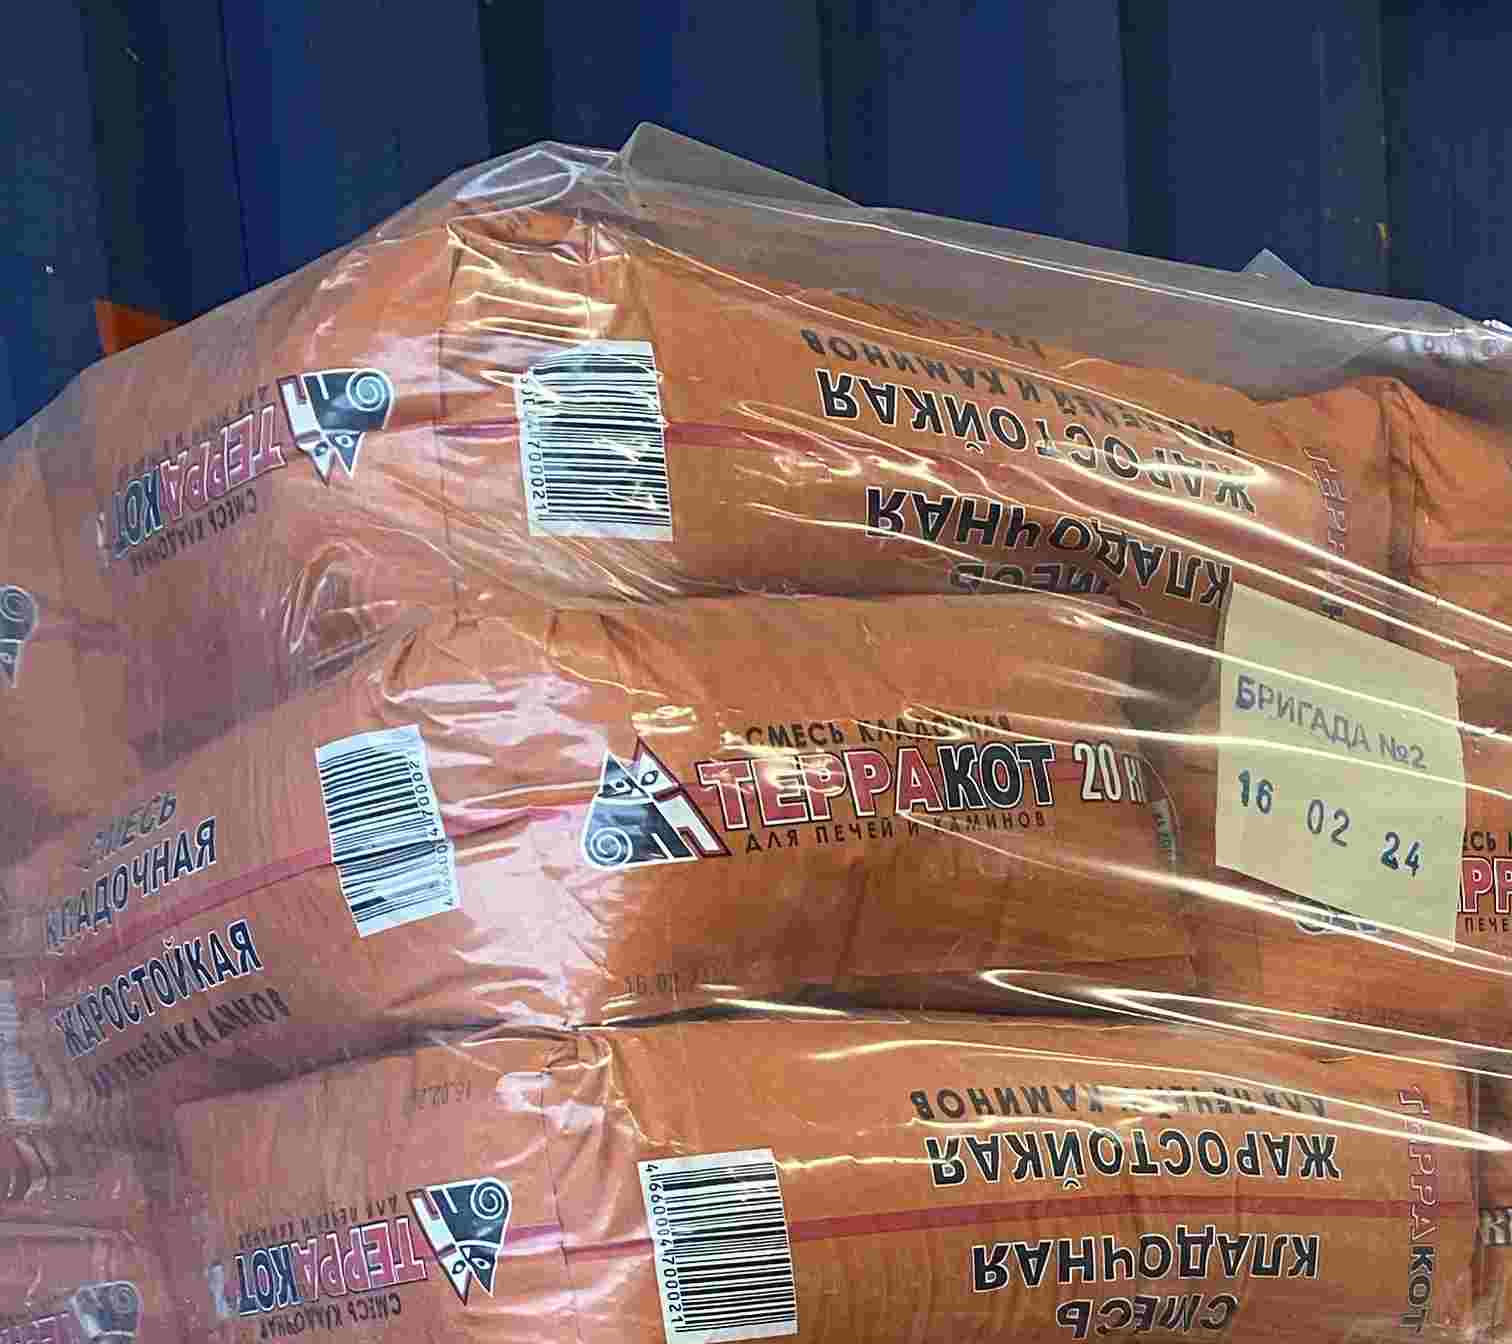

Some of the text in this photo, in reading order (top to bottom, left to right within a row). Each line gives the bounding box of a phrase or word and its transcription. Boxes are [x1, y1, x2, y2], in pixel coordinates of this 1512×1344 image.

[864, 488, 1234, 609] КЛАДОЧНАЯ
[745, 721, 845, 750] СМЕСЬ
[1235, 676, 1427, 770] БРИГАДА №2
[697, 742, 1120, 833] ТЕРРАКОТ 20
[745, 811, 1046, 853] ДЛЯ ПЕЧЕЙ И КАМИНОВ
[1238, 770, 1422, 877] 16 02 24
[57, 919, 264, 1060] ЖАРОСТОЙКАЯ
[925, 1129, 1342, 1191] ЖАРОСТОЙКАЯ
[236, 1220, 429, 1317] ТЕРРАКОТ
[971, 1224, 1319, 1294] КЛАДОЧНАЯ
[1055, 1293, 1239, 1339] СМЕСЬ
